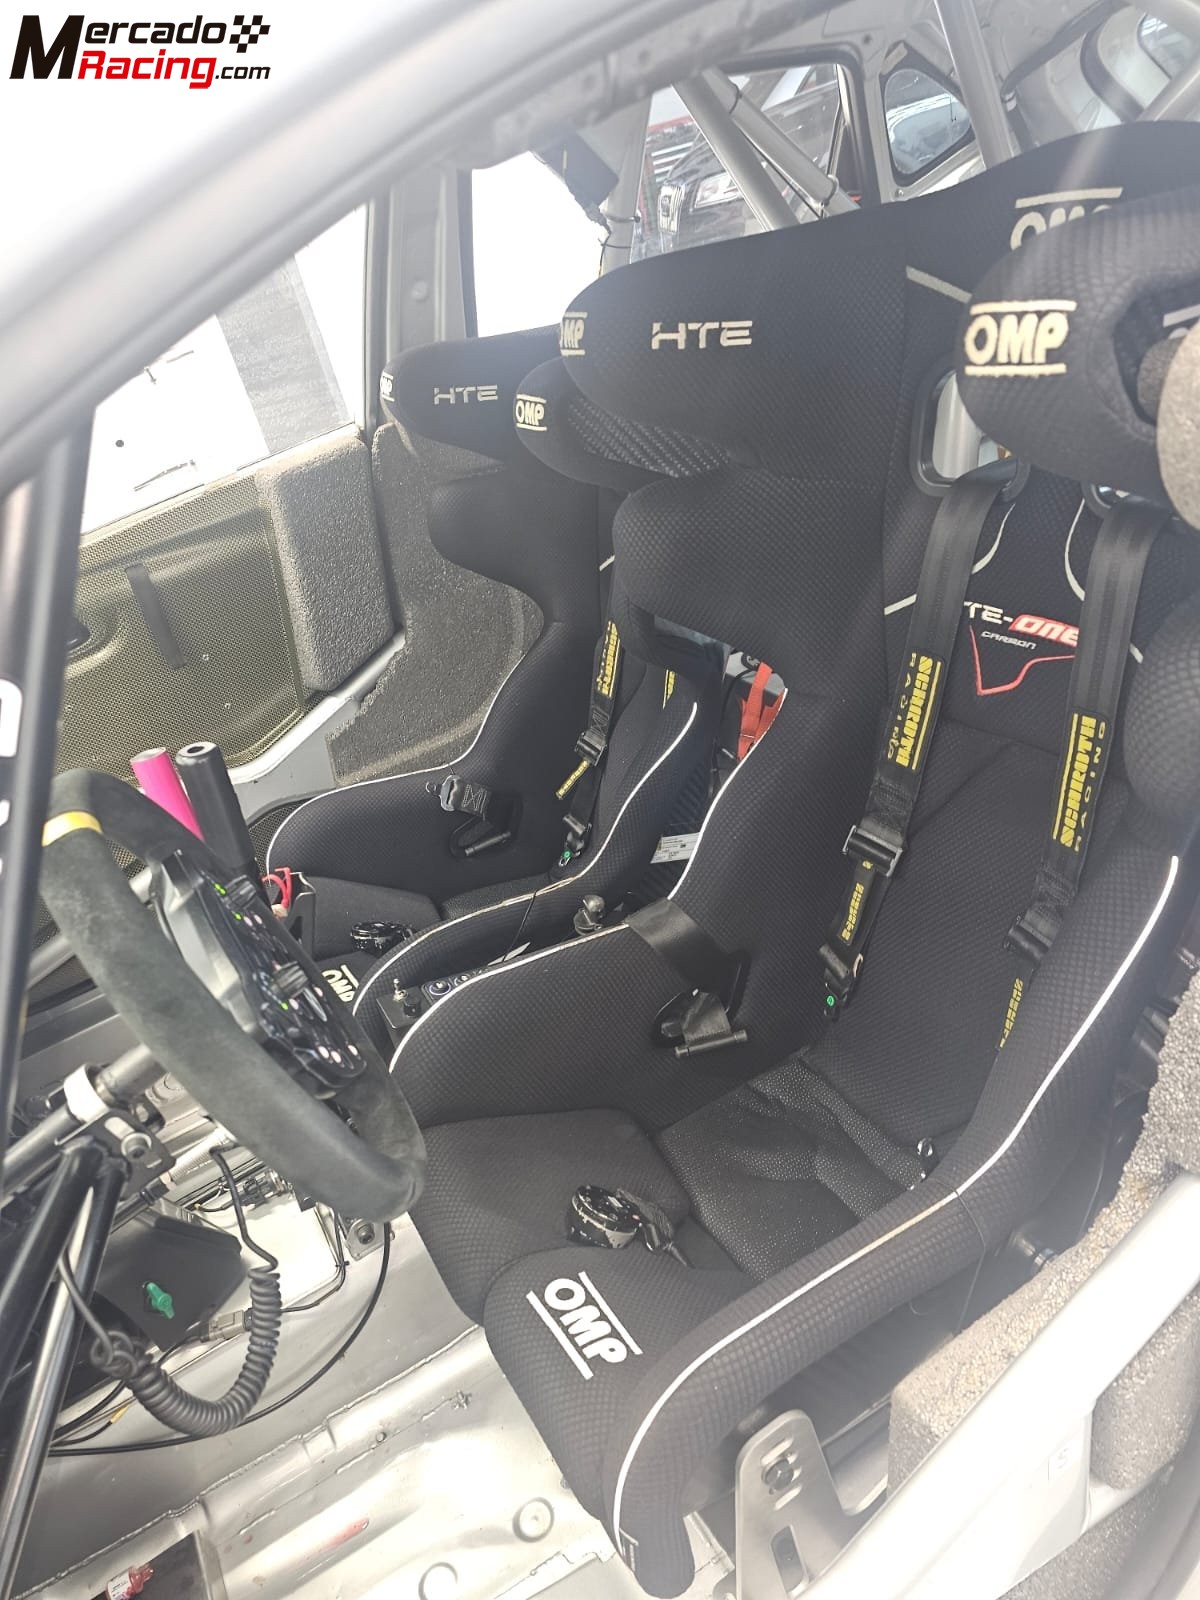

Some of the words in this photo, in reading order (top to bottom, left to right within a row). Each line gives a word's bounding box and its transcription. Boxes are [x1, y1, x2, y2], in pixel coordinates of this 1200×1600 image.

[651, 320, 753, 349] HTE
[964, 311, 1069, 365] OMP
[433, 384, 498, 405] HTE
[515, 400, 545, 426] OMP
[963, 601, 1079, 645] TE-ONE
[980, 630, 1037, 650] CARBON
[895, 655, 933, 767] SCHROTH
[1060, 715, 1097, 848] SCHROTH
[544, 1278, 628, 1363] OMP
